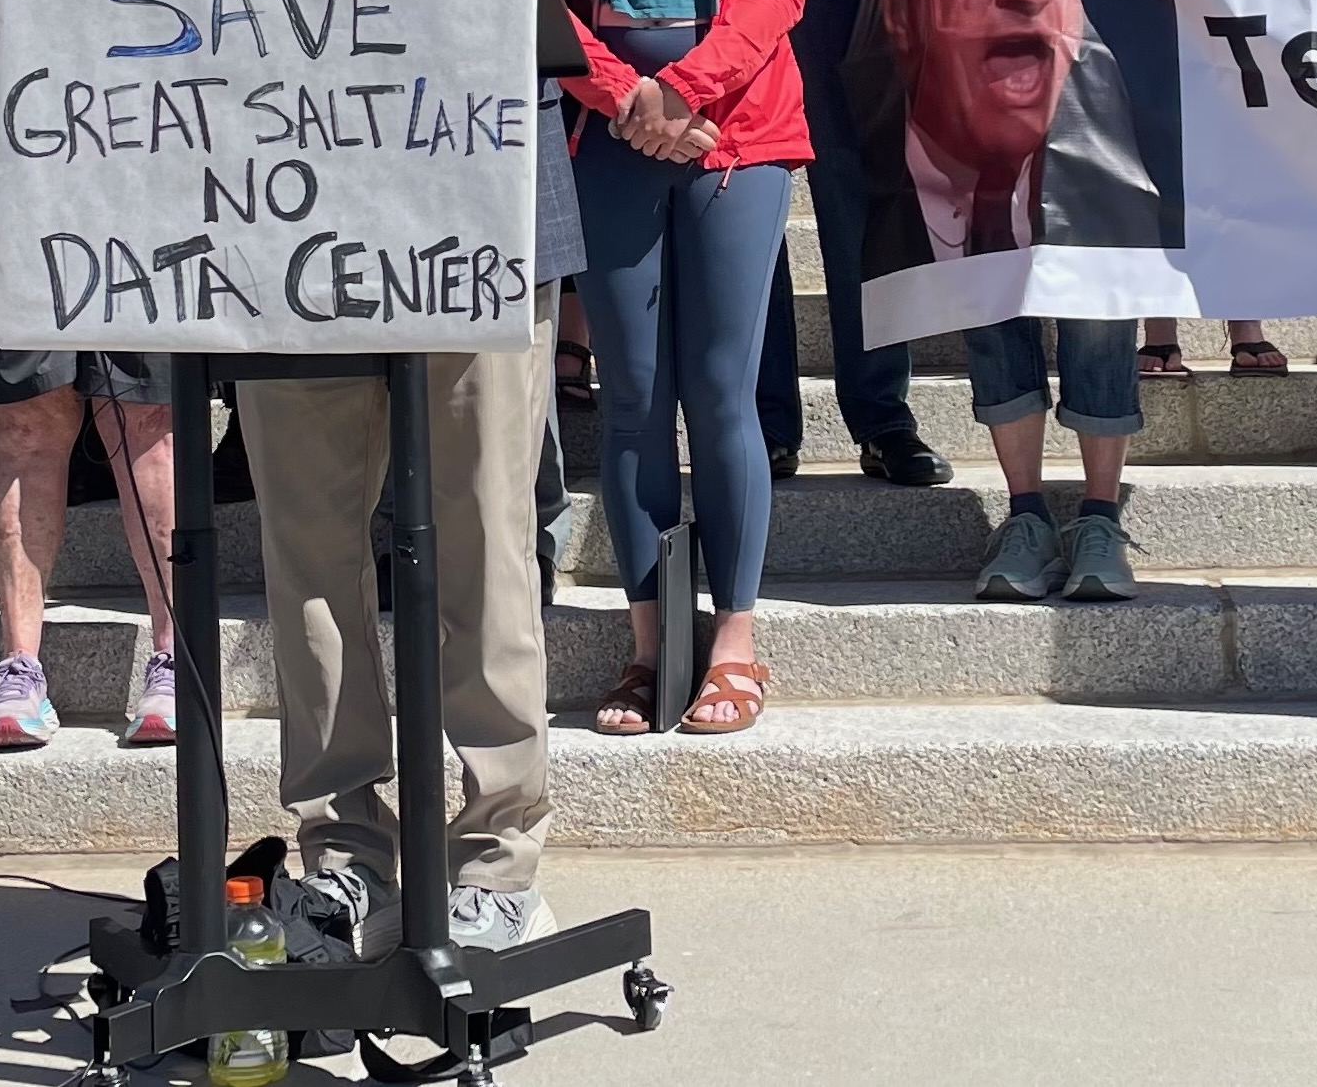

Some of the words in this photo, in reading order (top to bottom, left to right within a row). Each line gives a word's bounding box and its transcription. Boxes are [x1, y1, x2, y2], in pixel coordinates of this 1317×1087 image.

[4, 68, 228, 164] GREAT
[243, 80, 405, 151] SALT
[405, 76, 529, 157] LAKE
[203, 158, 319, 224] NO
[41, 232, 262, 331] DATA
[284, 231, 527, 323] CENTERS
